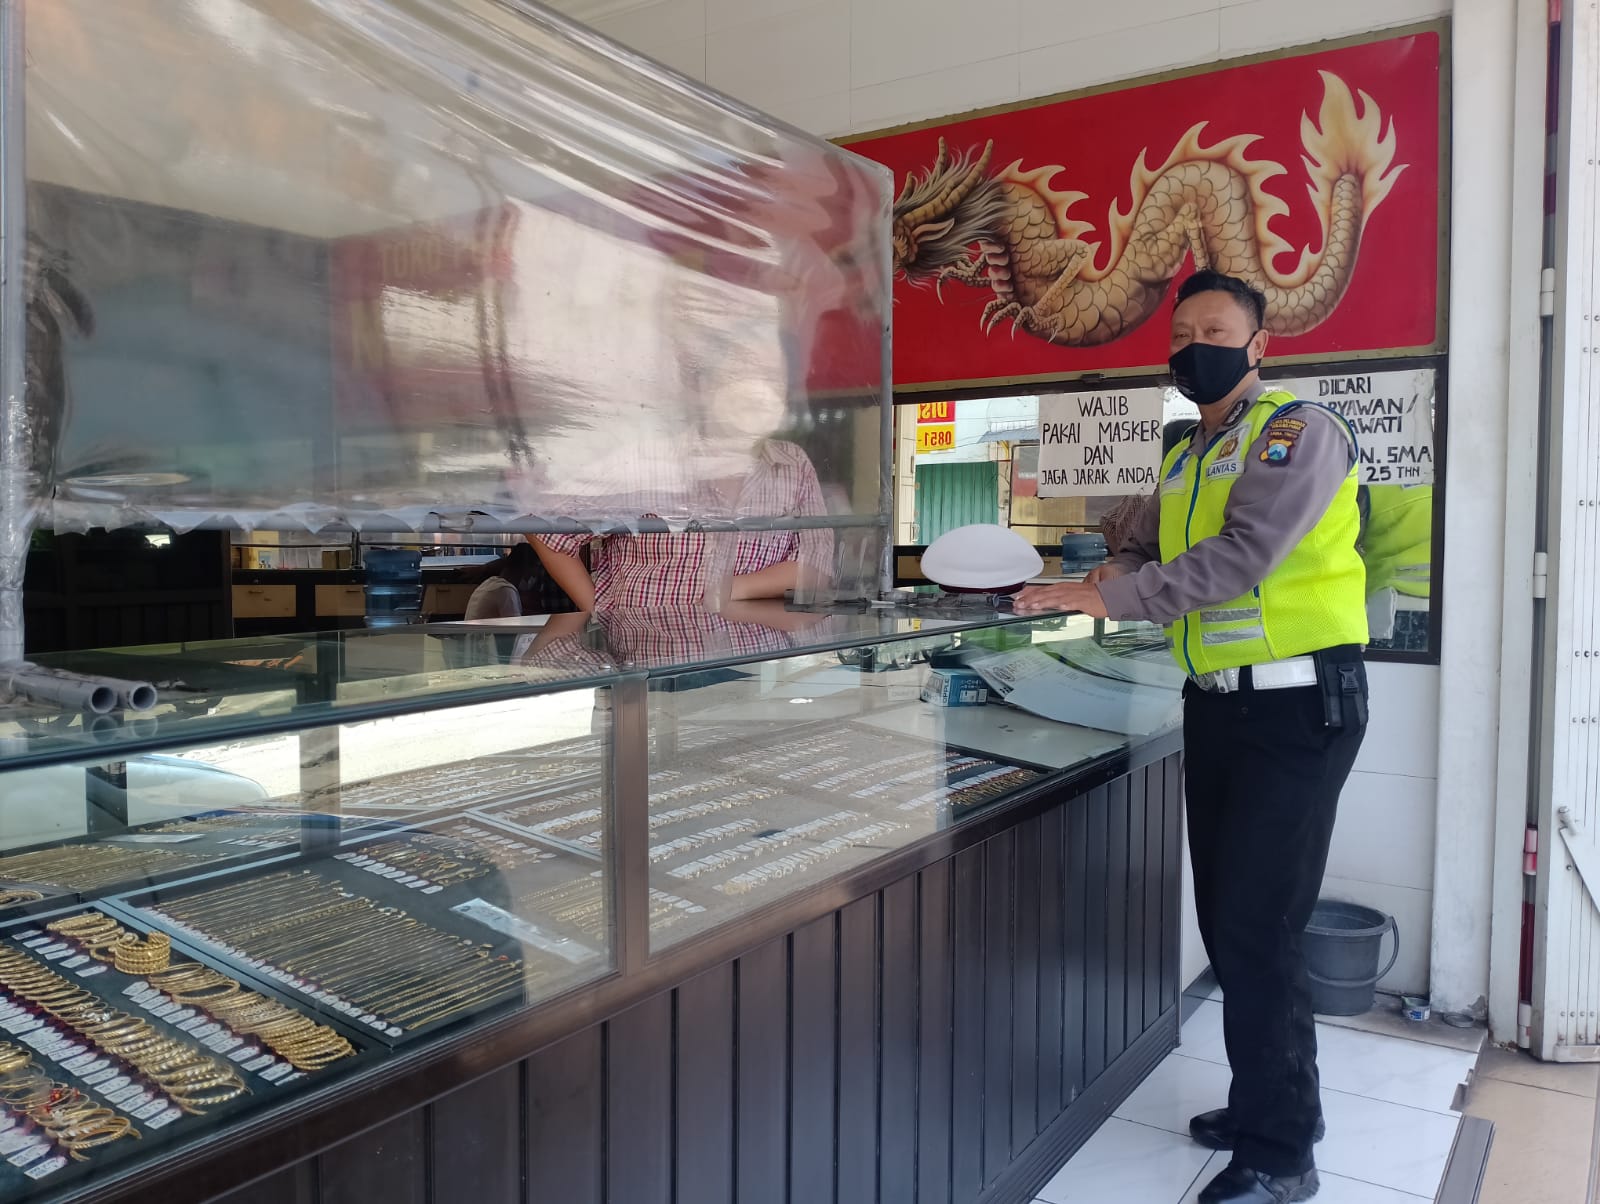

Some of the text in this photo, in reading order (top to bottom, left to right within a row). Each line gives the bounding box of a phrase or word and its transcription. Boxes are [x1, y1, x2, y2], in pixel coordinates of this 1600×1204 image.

[1319, 376, 1371, 396] DICARI
[1077, 395, 1129, 417] WAJIB
[1042, 420, 1161, 445] PAKAI MASKER
[1349, 416, 1402, 434] AWATI
[1083, 445, 1114, 466] DAN
[1360, 446, 1432, 464] N. SMA
[1041, 466, 1155, 486] JAGA JARAK ANDA
[1366, 466, 1420, 482] 25 THN
